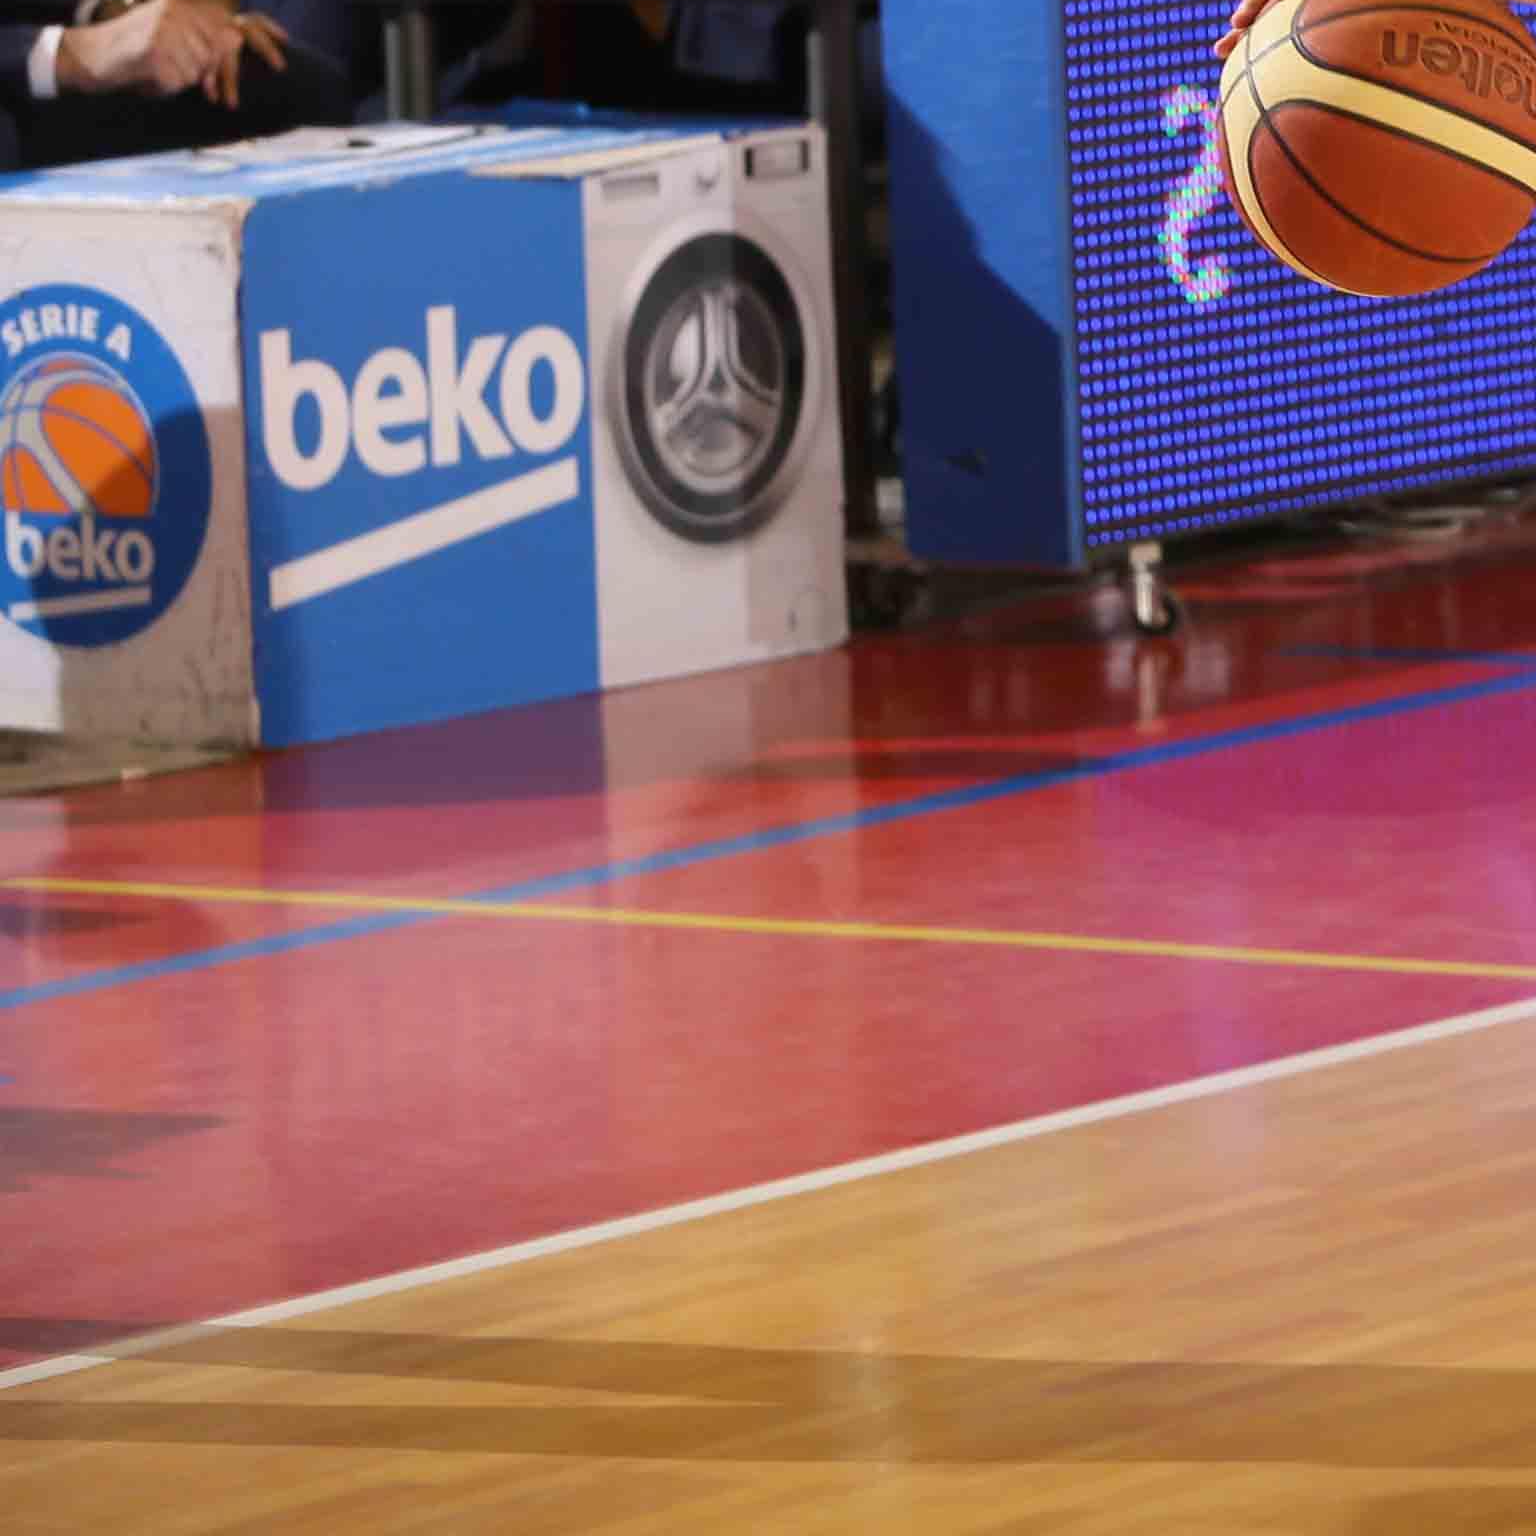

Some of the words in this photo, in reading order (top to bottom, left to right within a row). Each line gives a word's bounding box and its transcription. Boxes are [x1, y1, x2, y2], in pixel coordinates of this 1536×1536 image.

[1, 302, 100, 358] SERIE
[106, 321, 133, 362] A
[257, 304, 586, 492] beko
[4, 508, 156, 579] beko
